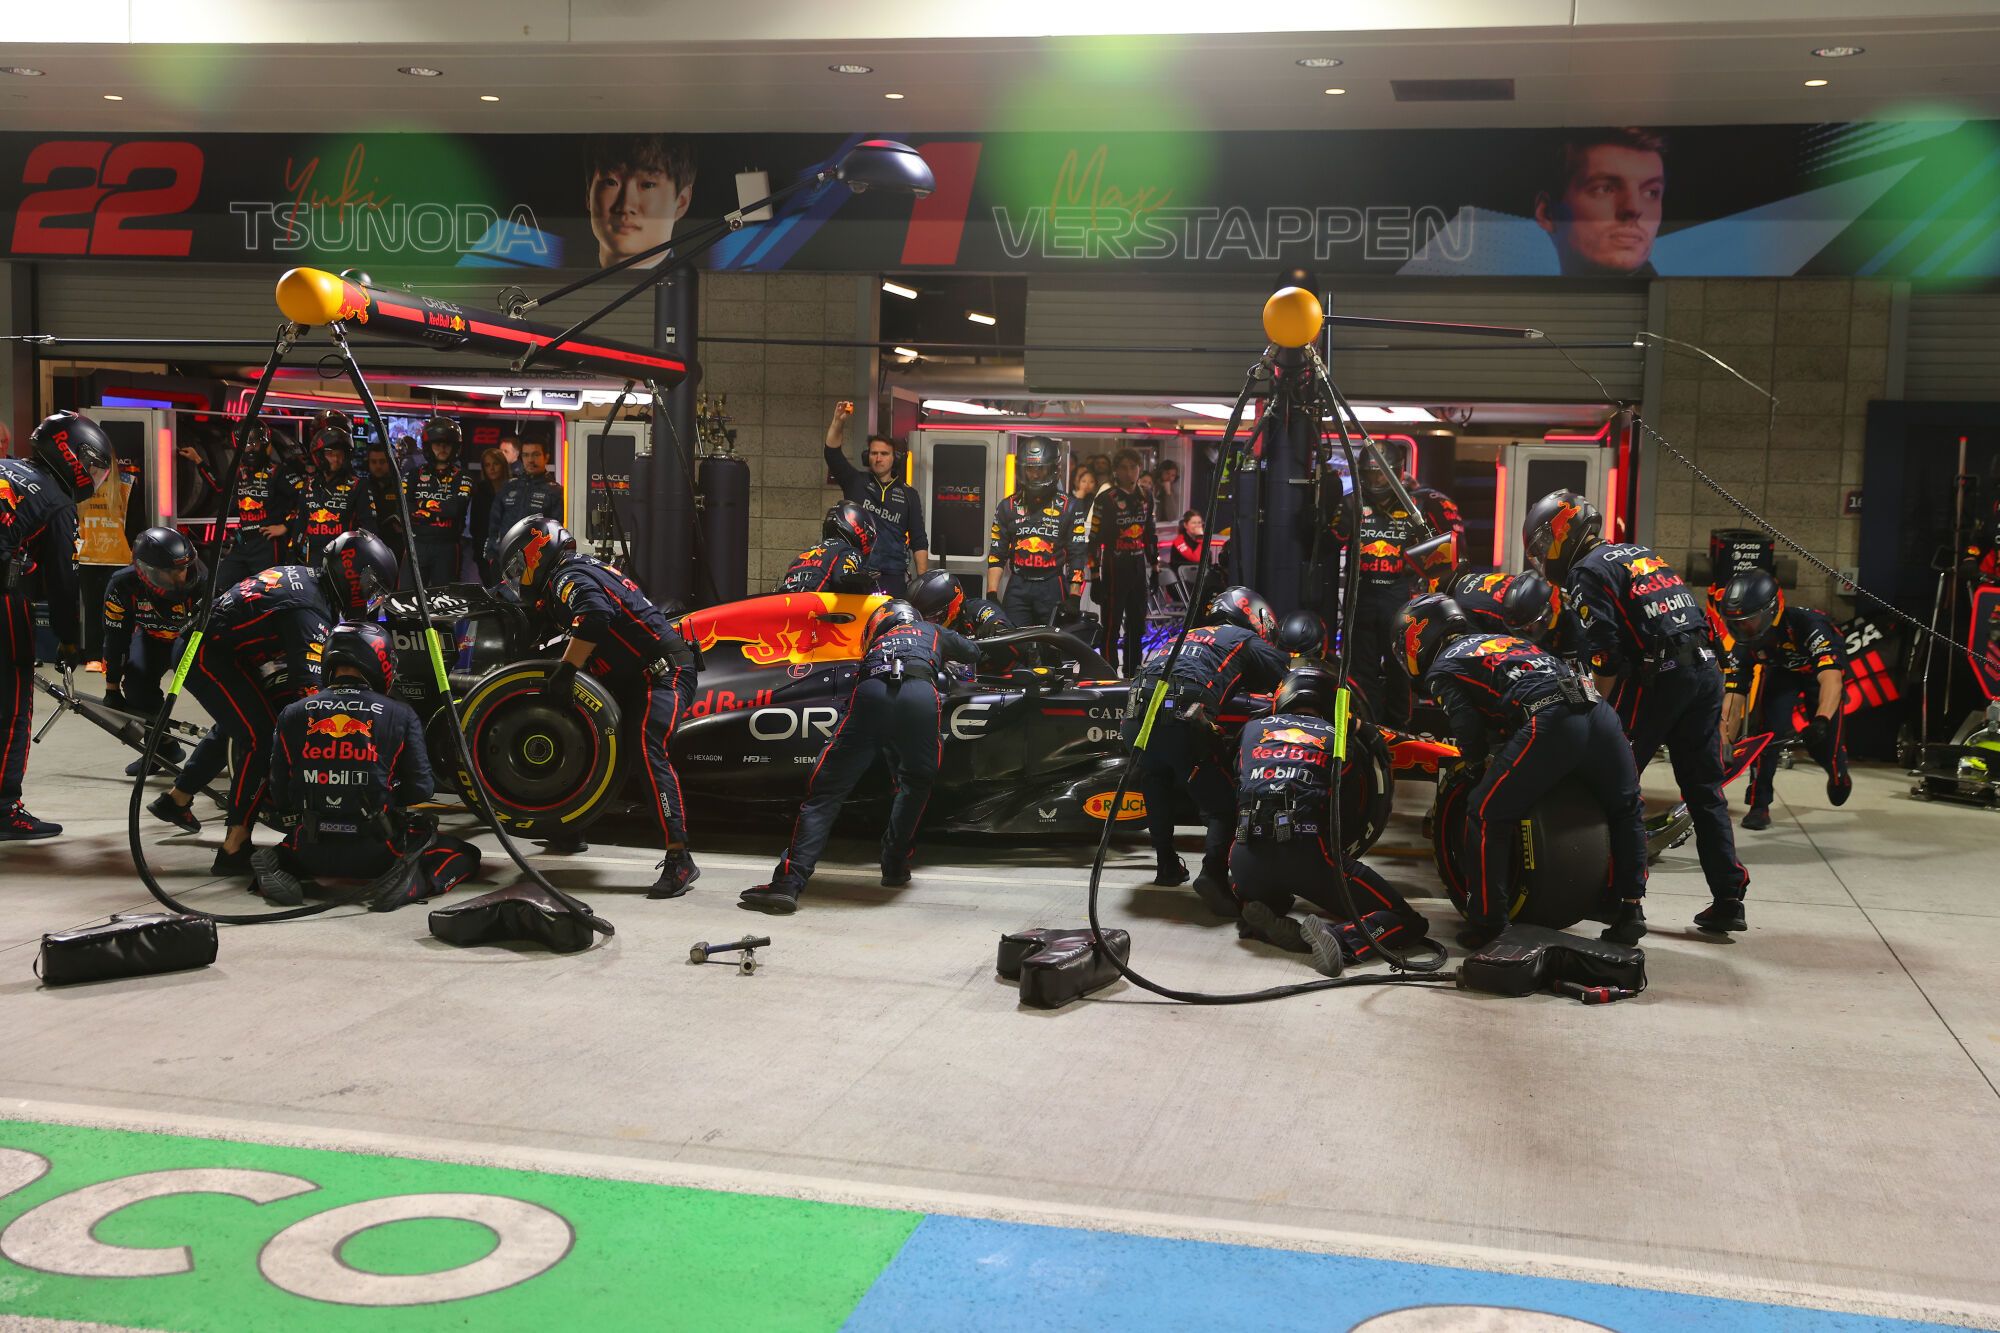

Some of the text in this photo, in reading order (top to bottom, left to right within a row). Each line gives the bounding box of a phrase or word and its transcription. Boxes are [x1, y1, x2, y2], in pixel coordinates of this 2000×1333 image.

[286, 143, 392, 242] Yuki
[1050, 145, 1174, 228] Max
[12, 141, 204, 256] 22
[230, 202, 547, 254] TSUNODA
[993, 205, 1474, 261] VERSTAPPEN
[0, 464, 41, 495] RACLE
[862, 499, 900, 524] Red Bull
[320, 522, 342, 535] Bull
[1016, 527, 1059, 537] ORACLE
[1360, 529, 1407, 540] ORACLE
[341, 549, 361, 579] Red
[1015, 553, 1057, 567] Red Bull
[1380, 559, 1403, 573] Bull
[283, 565, 304, 591] RACLE
[1630, 575, 1661, 600] Red
[1644, 594, 1684, 619] Mobil
[392, 630, 425, 651] bil
[371, 637, 393, 673] Red
[307, 664, 322, 674] VIS
[305, 700, 384, 715] ORACLE
[1089, 708, 1124, 719] CAR
[750, 704, 991, 740] ORE
[1261, 717, 1336, 734] ORACLE
[1105, 730, 1124, 740] 1Pa
[339, 741, 378, 762] Bull
[693, 754, 723, 762] HEXAGON
[793, 756, 816, 764] SIEM
[1252, 744, 1328, 768] Red Bull
[304, 769, 349, 784] Mobil
[1250, 766, 1296, 781] Mobil
[320, 822, 358, 832] sparco
[0, 1147, 576, 1307] CO
